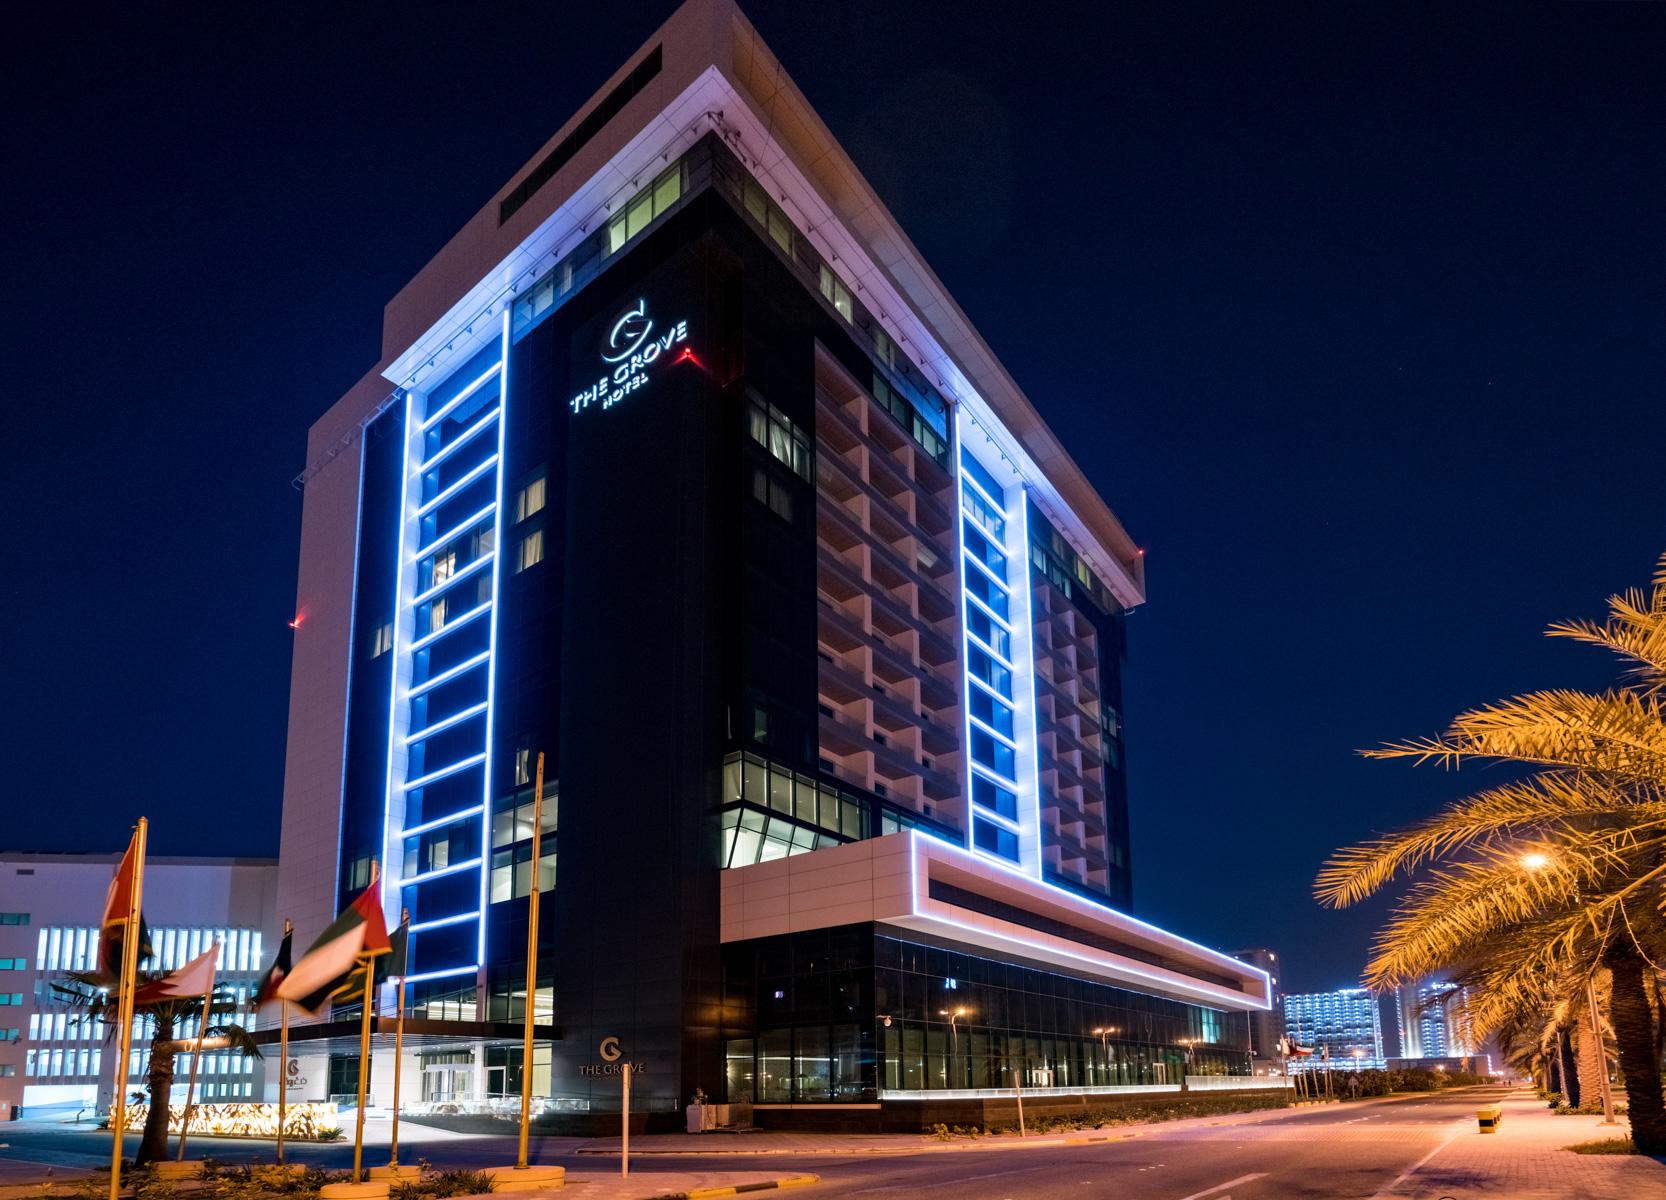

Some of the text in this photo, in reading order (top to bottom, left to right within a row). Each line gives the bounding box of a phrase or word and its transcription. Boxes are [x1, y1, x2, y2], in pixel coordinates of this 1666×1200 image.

[570, 320, 687, 413] THE GROVE
[603, 372, 649, 409] HOTEL
[578, 1065, 600, 1075] THE
